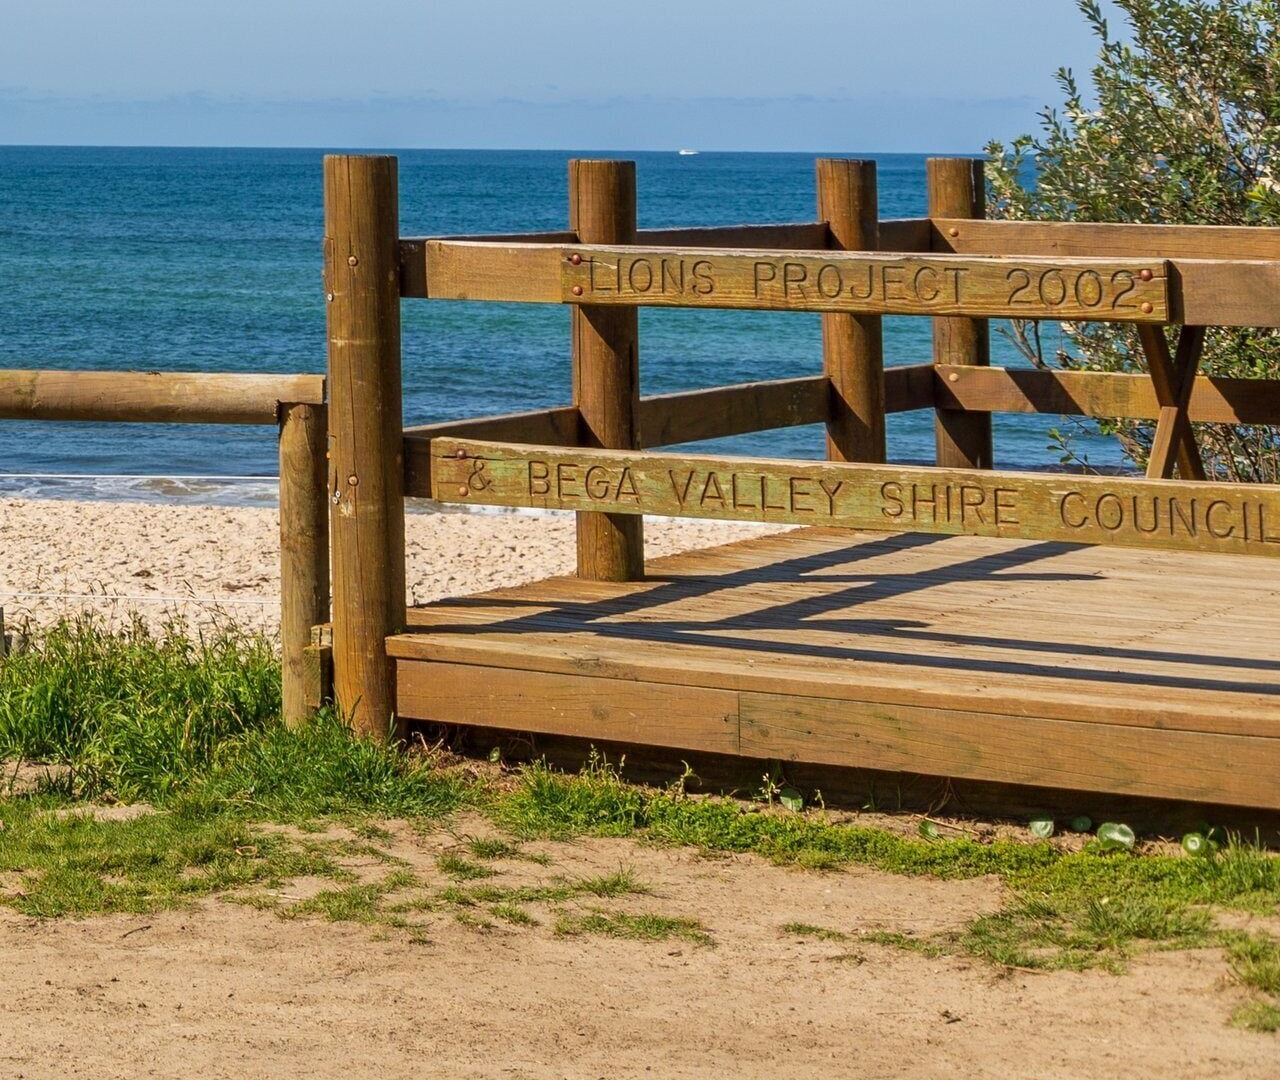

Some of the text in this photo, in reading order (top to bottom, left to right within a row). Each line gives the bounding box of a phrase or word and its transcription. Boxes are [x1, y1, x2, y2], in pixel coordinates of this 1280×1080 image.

[590, 255, 1138, 310] LIONS PROJECT 2002
[467, 455, 1280, 544] & BEGA VALLEY SHIRE COUNCIL
